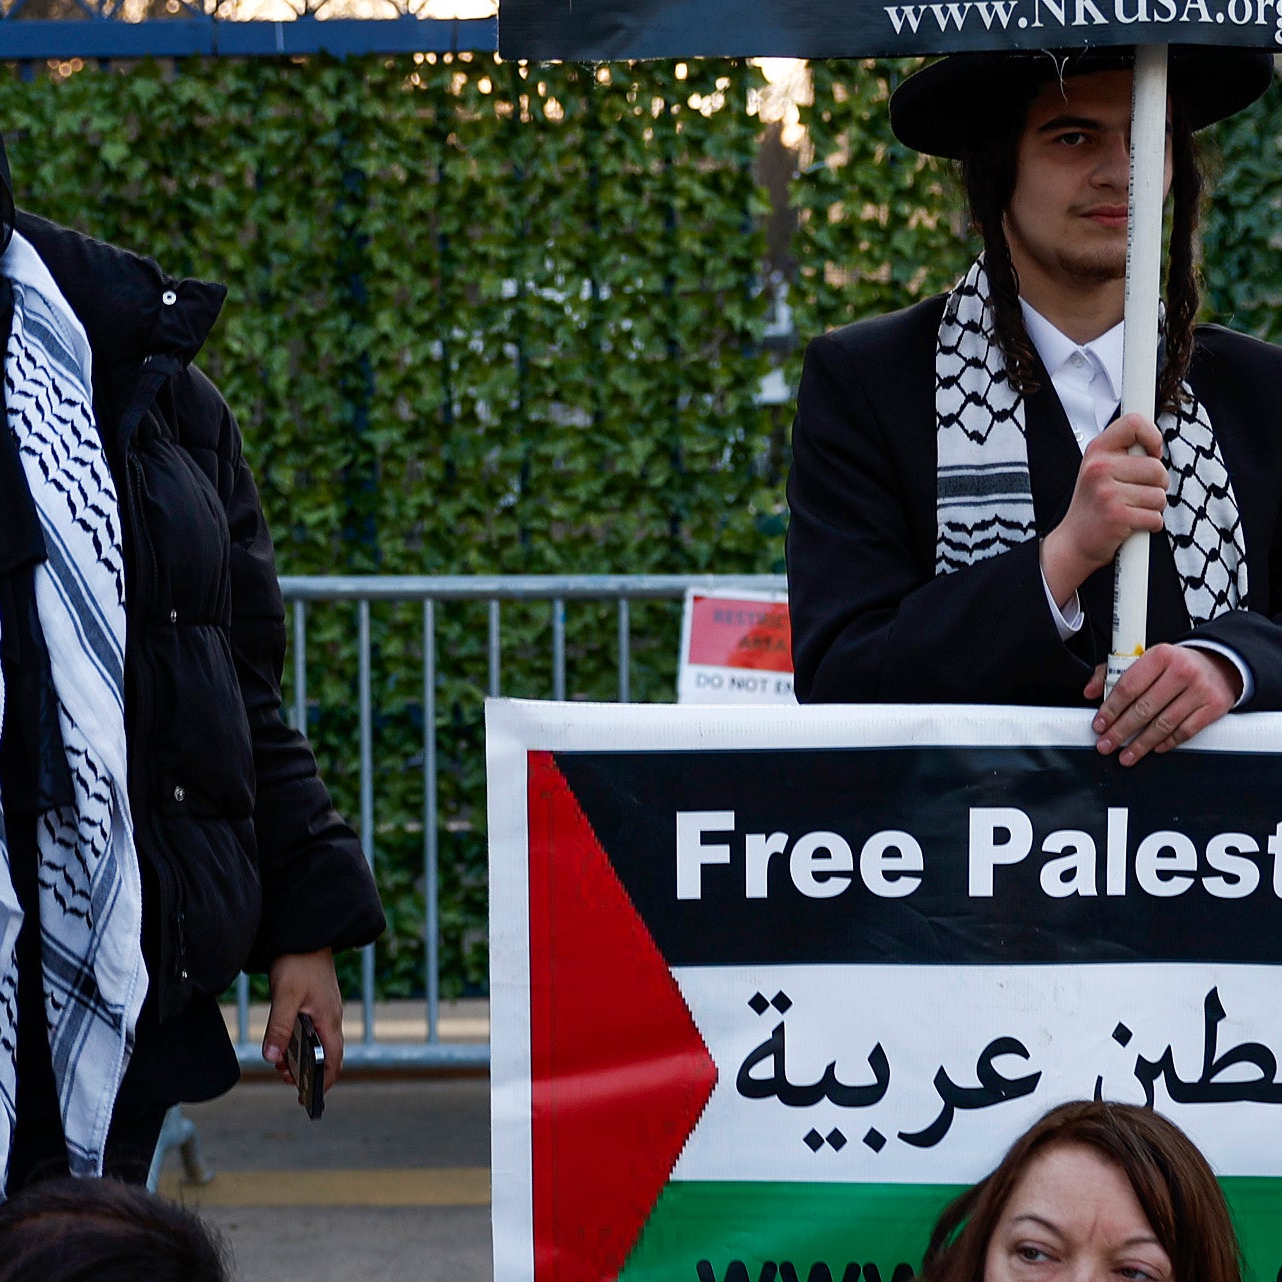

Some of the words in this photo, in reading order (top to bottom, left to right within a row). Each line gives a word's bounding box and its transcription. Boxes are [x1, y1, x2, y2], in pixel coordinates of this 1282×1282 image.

[696, 673, 724, 691] DO
[729, 677, 768, 694] NOT
[676, 810, 924, 900] Free
[735, 989, 1043, 1154] عربية
